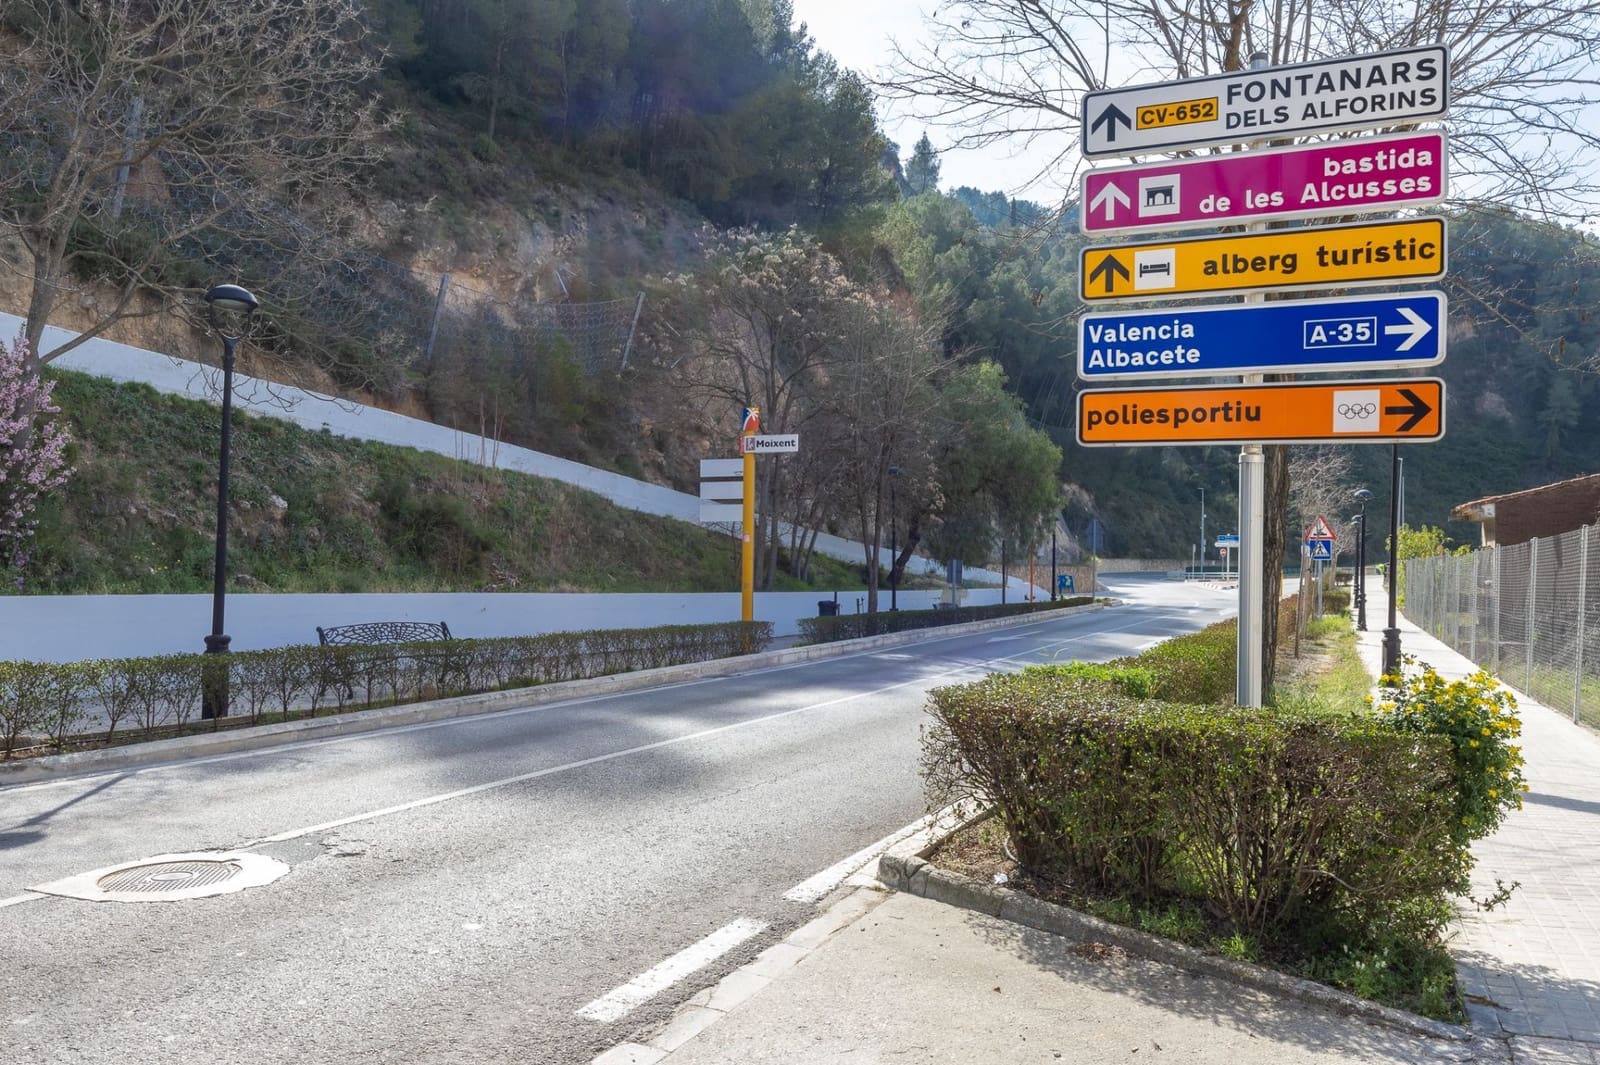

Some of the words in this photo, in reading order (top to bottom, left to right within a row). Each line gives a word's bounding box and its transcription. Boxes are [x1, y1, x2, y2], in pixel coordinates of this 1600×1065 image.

[1226, 57, 1437, 106] FONTANARS
[1140, 102, 1214, 125] CV-652
[1225, 106, 1290, 130] DELS
[1301, 87, 1437, 121] ALFORINS
[1324, 148, 1433, 177] bastida
[1199, 194, 1231, 214] de
[1246, 189, 1284, 209] les
[1300, 174, 1432, 204] Alcusses
[1202, 252, 1298, 275] alberg
[1316, 238, 1436, 267] turístic
[1088, 320, 1195, 344] Valencia
[1310, 322, 1371, 344] A-35
[1088, 345, 1201, 369] Albacete
[1087, 401, 1262, 431] poliesportiu
[756, 439, 796, 448] Moixent
